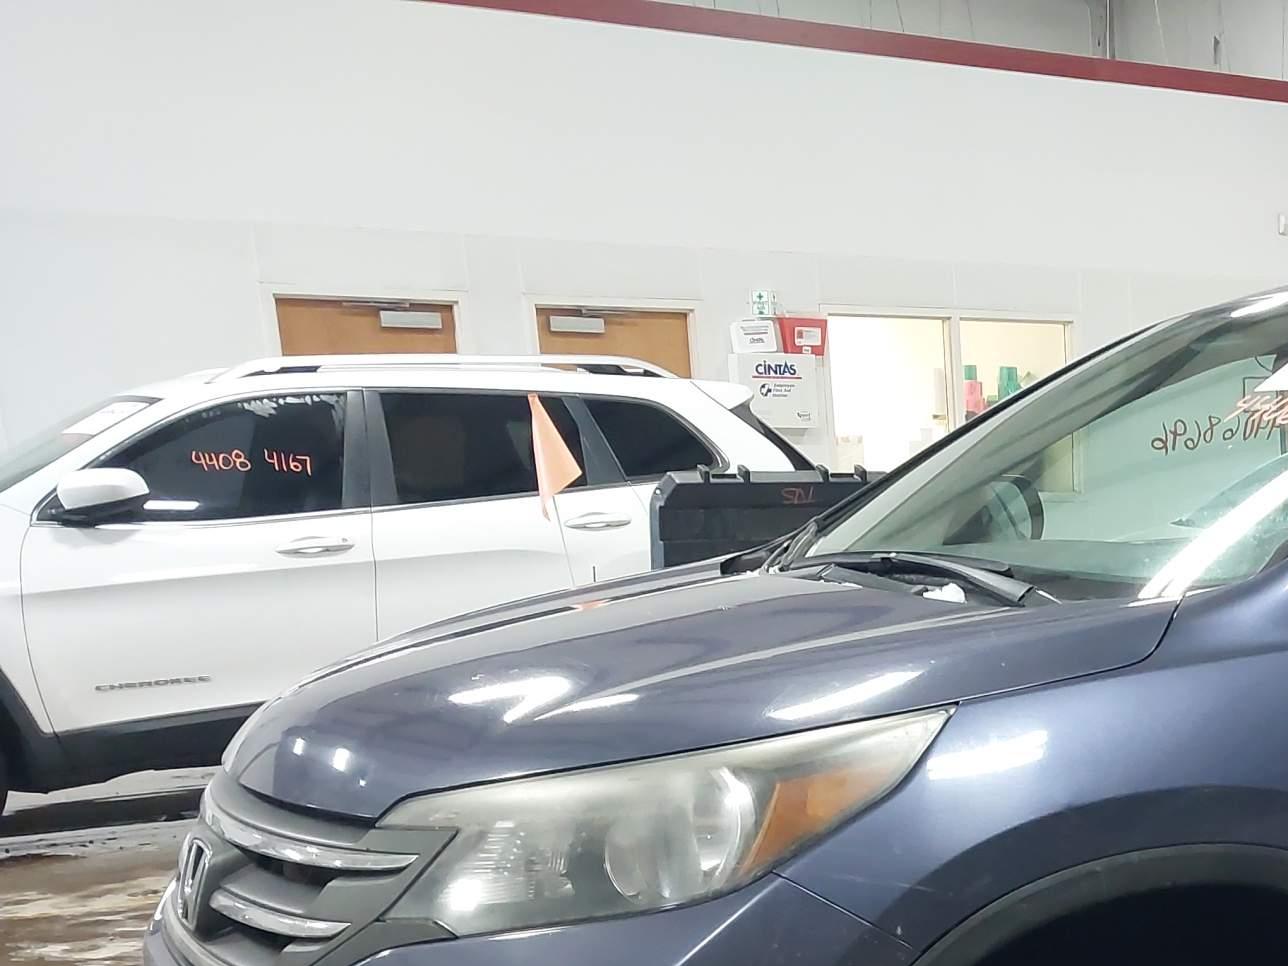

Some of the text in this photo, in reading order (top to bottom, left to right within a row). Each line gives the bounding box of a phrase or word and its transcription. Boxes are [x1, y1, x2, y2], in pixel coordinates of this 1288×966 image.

[755, 360, 796, 376] CINTAS
[191, 448, 312, 476] 4408 4167
[95, 675, 211, 692] CHEROKEE
